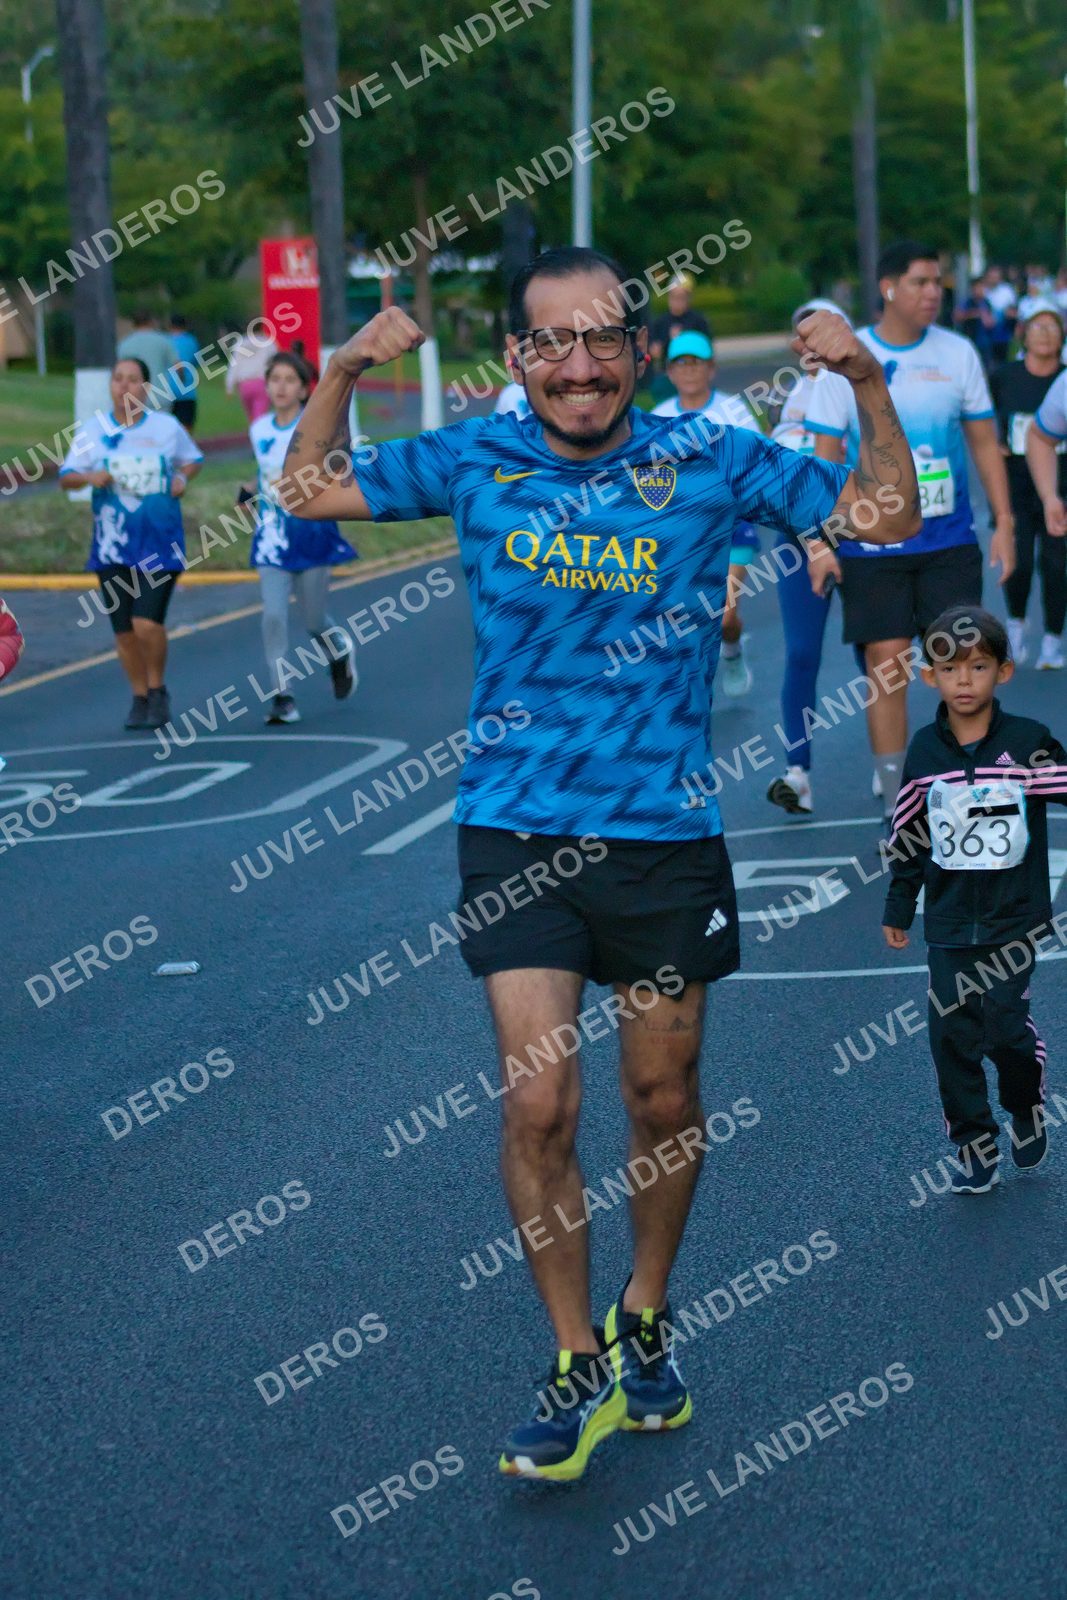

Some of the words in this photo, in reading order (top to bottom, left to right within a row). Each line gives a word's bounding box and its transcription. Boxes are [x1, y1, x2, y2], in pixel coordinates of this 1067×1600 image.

[640, 478, 671, 487] CABJ
[506, 530, 658, 572] QATAR
[542, 568, 658, 594] AIRWAYS
[938, 819, 1011, 858] 363
